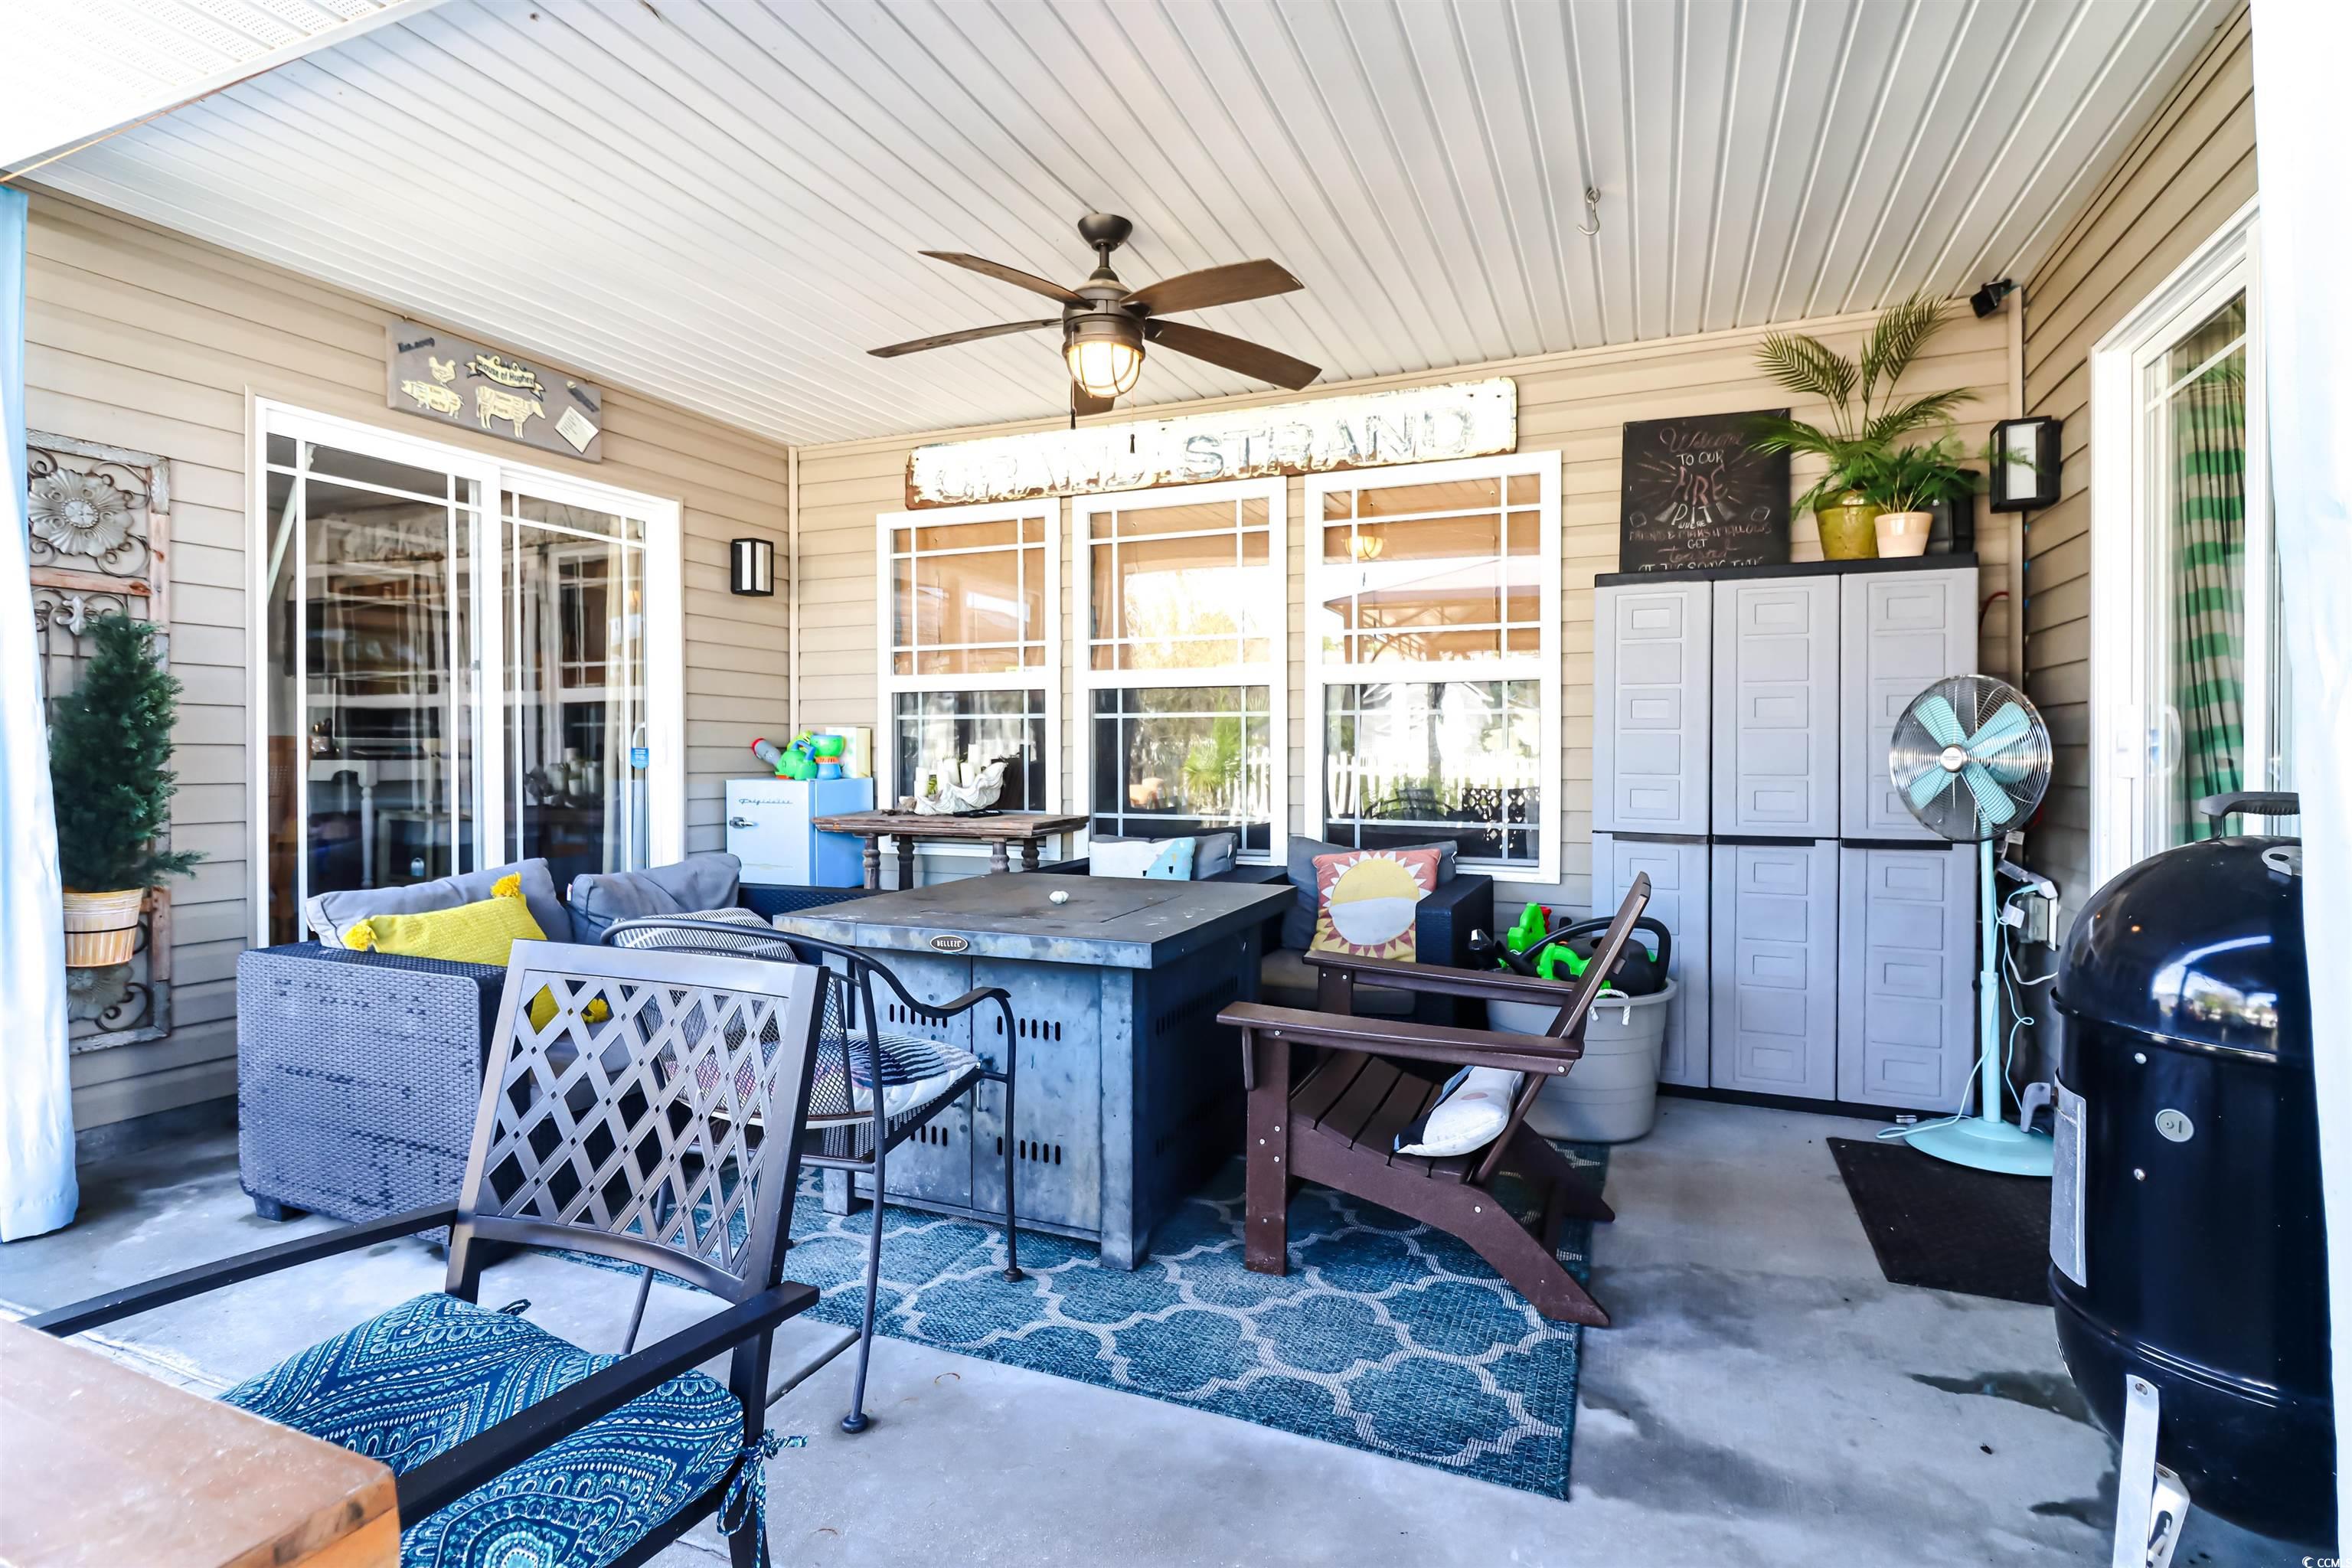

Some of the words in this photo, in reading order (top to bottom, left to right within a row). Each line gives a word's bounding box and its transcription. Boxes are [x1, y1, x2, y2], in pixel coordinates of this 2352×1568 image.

[1180, 405, 1476, 480] STRAND
[1660, 427, 1744, 452] Welcome
[1676, 453, 1694, 466] TO
[1698, 449, 1725, 464] OUR
[1671, 466, 1728, 505] FIRE
[1671, 503, 1712, 526] PIT
[1677, 521, 1707, 530] WHERE
[1687, 538, 1708, 550] GET
